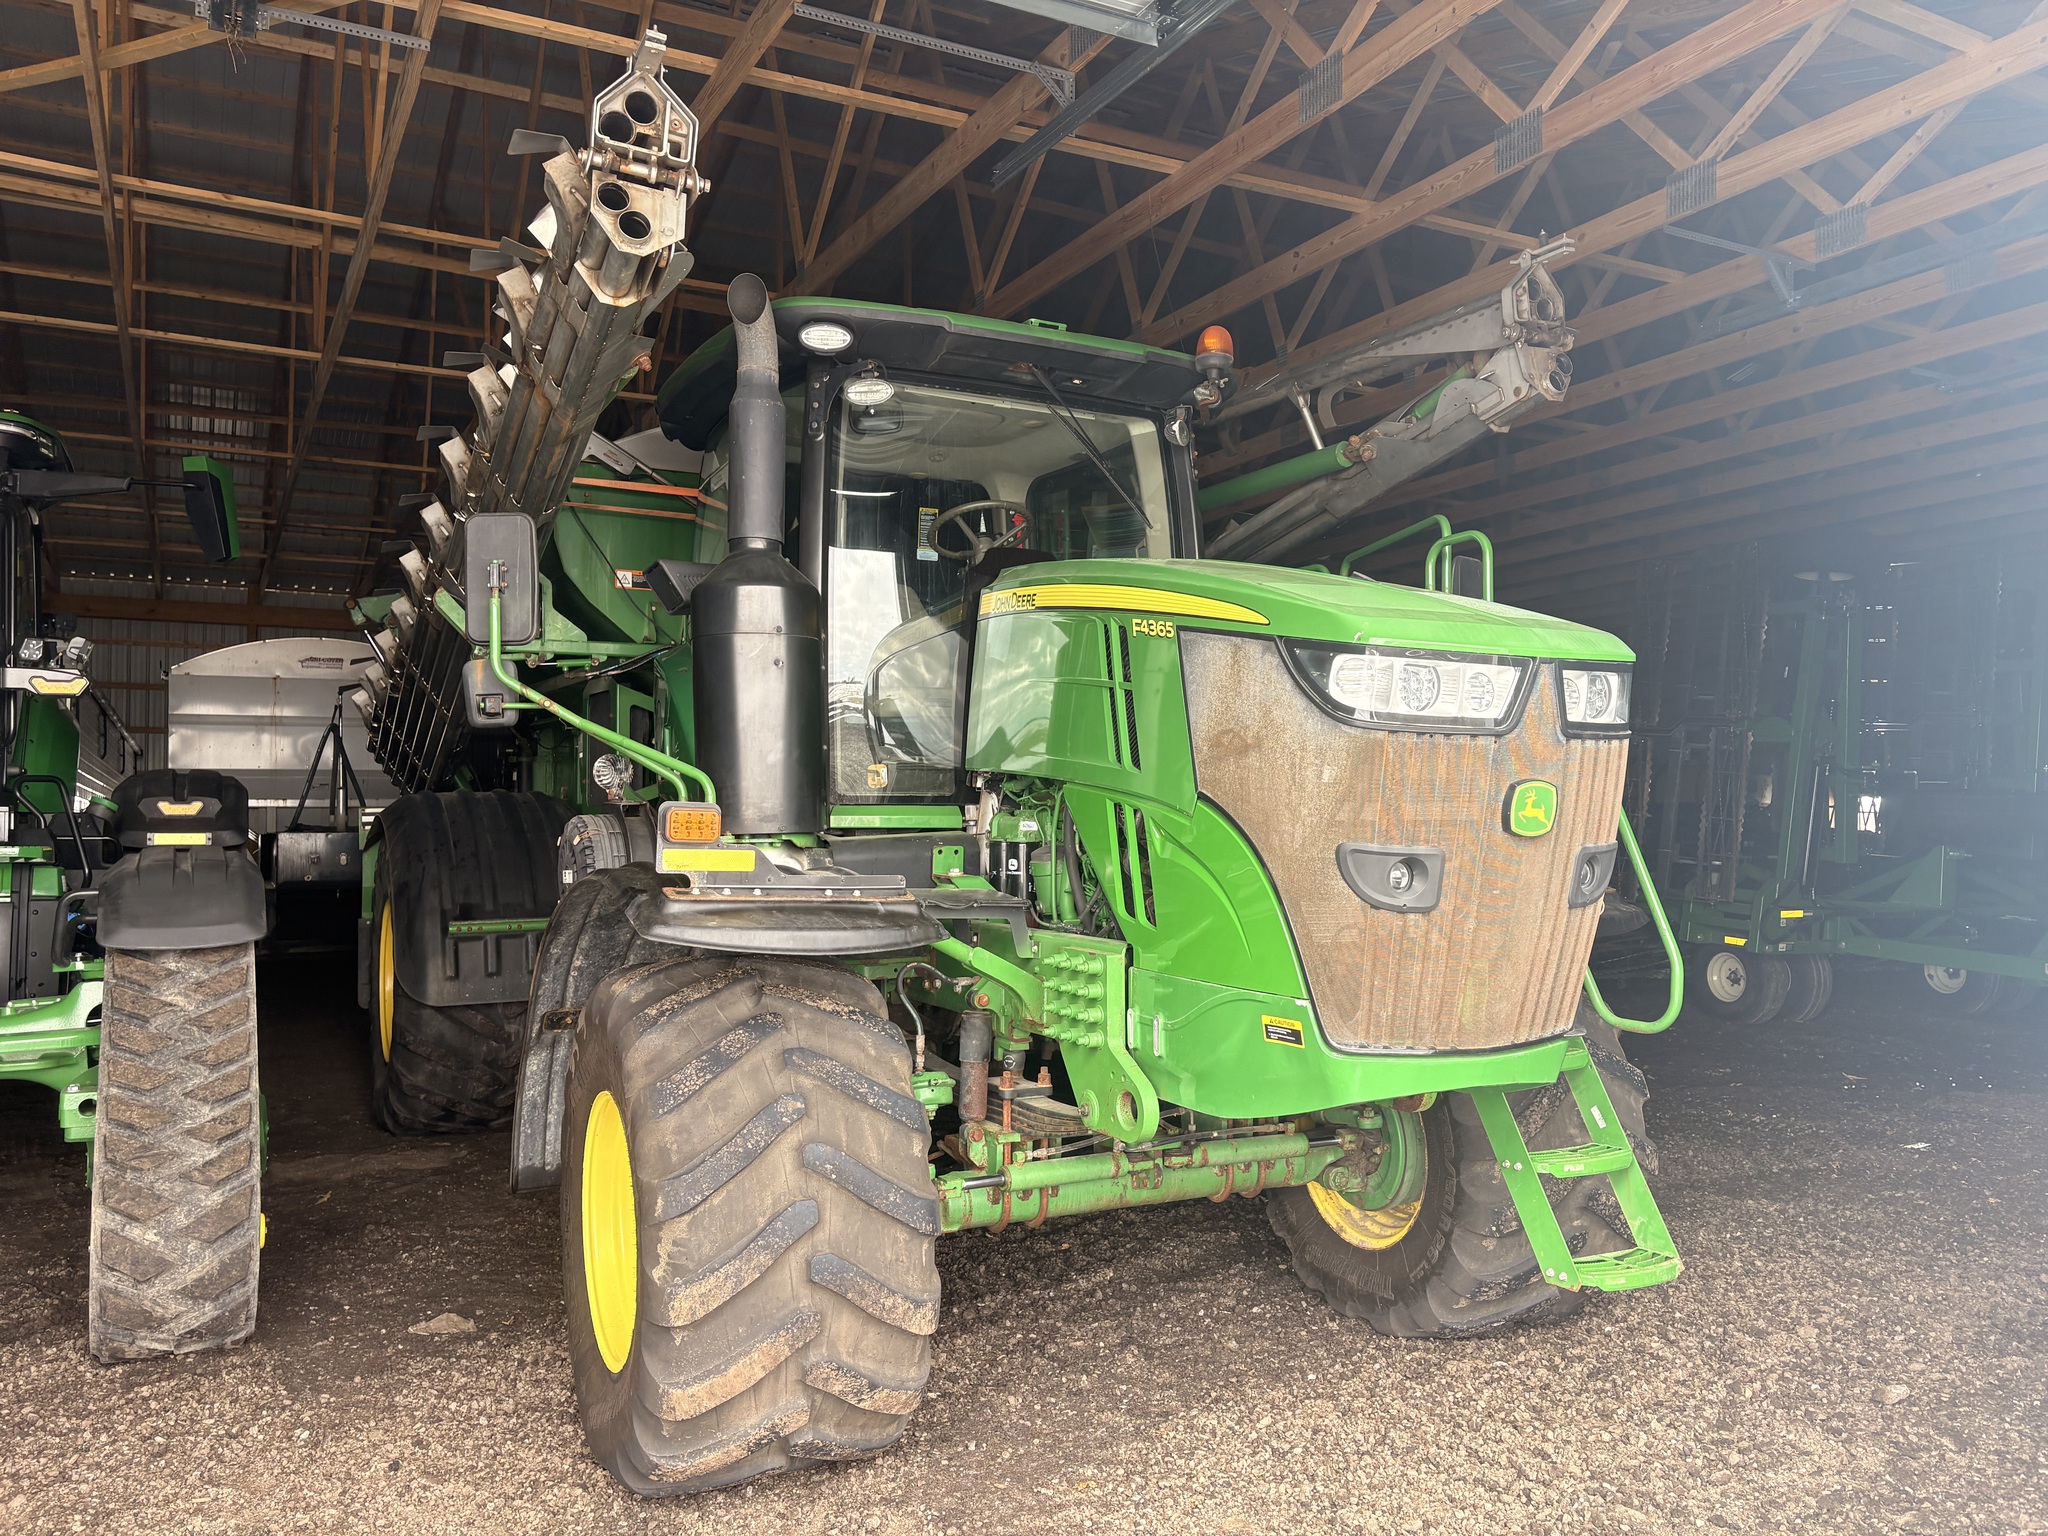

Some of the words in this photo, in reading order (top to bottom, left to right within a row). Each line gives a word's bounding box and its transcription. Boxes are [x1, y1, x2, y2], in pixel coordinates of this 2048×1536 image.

[1011, 592, 1037, 609] DEERE
[1132, 618, 1175, 638] F4365
[1426, 1229, 1446, 1264] 26
[1304, 1244, 1395, 1301] TRELLEBORG
